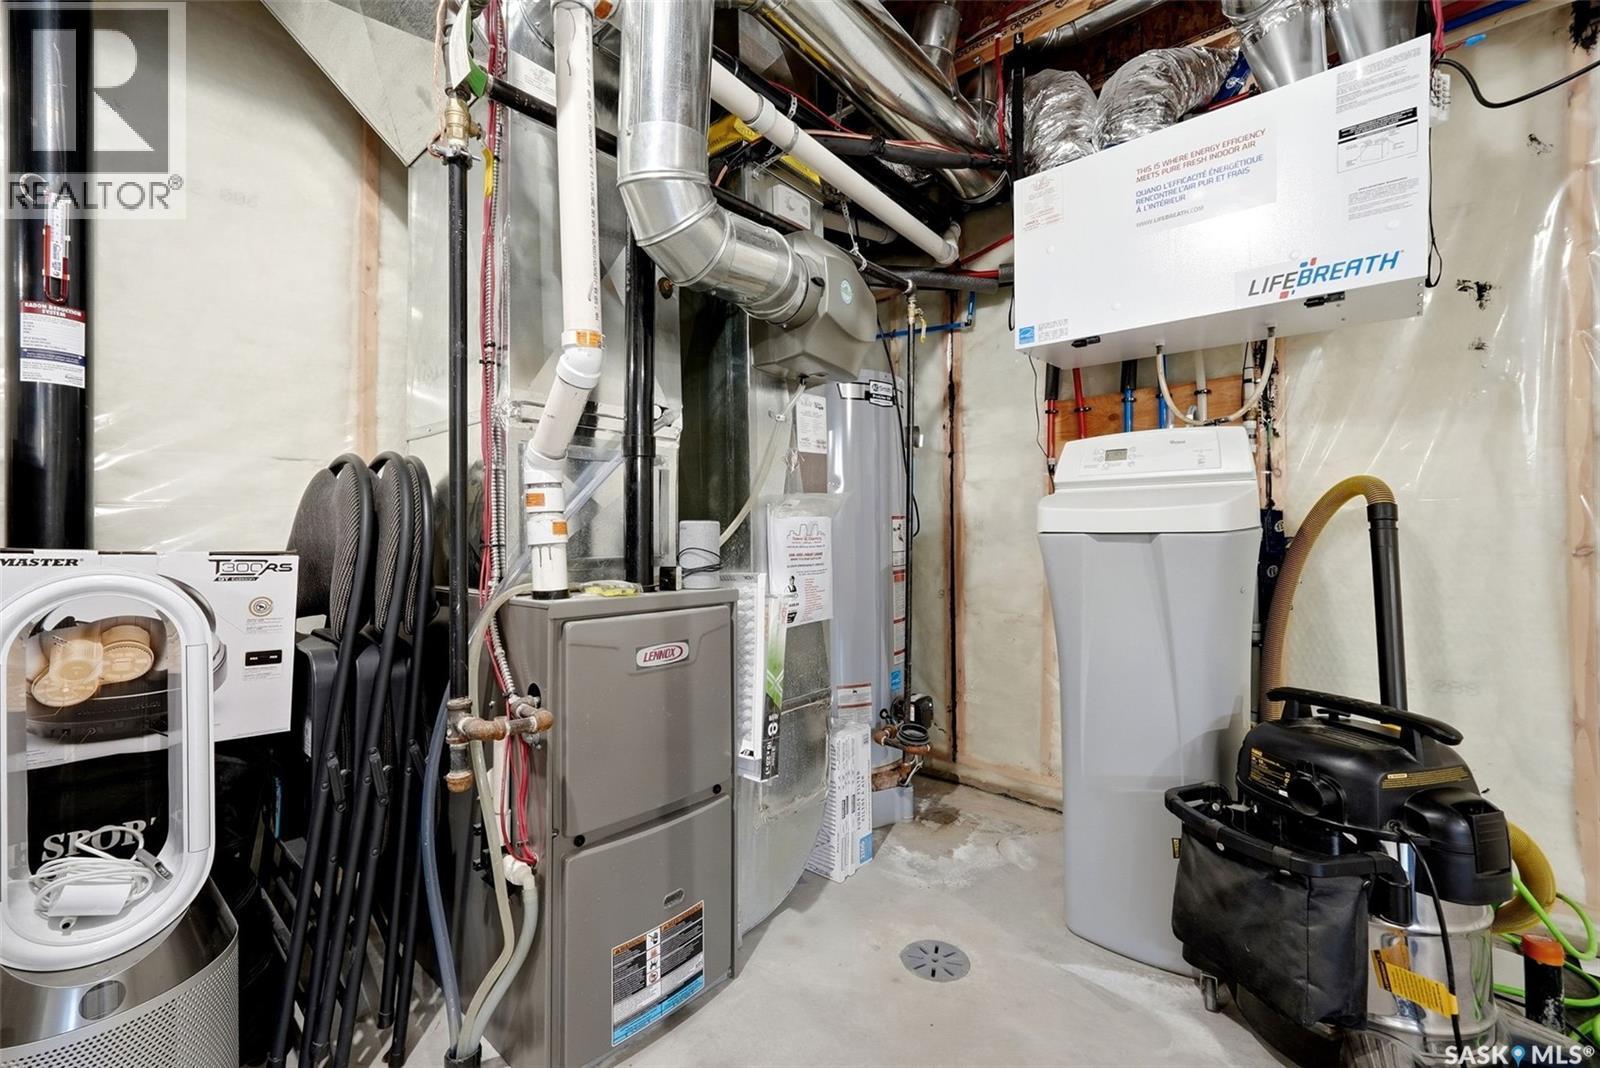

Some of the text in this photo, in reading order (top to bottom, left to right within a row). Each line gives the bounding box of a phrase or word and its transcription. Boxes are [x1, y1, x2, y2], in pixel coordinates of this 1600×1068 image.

[1136, 128, 1266, 175] THIS IS WHERE ENERGY EFFICIENCY
[1136, 141, 1257, 183] MEETS PURE FRESH INDOOR AIR
[1135, 189, 1177, 206] RENCONTRE
[1197, 177, 1214, 189] PUR
[1215, 174, 1226, 183] ET
[1227, 167, 1251, 180] FRAIS
[1135, 184, 1162, 198] QUAND
[1248, 250, 1401, 297] LIFEBREATH
[643, 647, 676, 662] LENNOX
